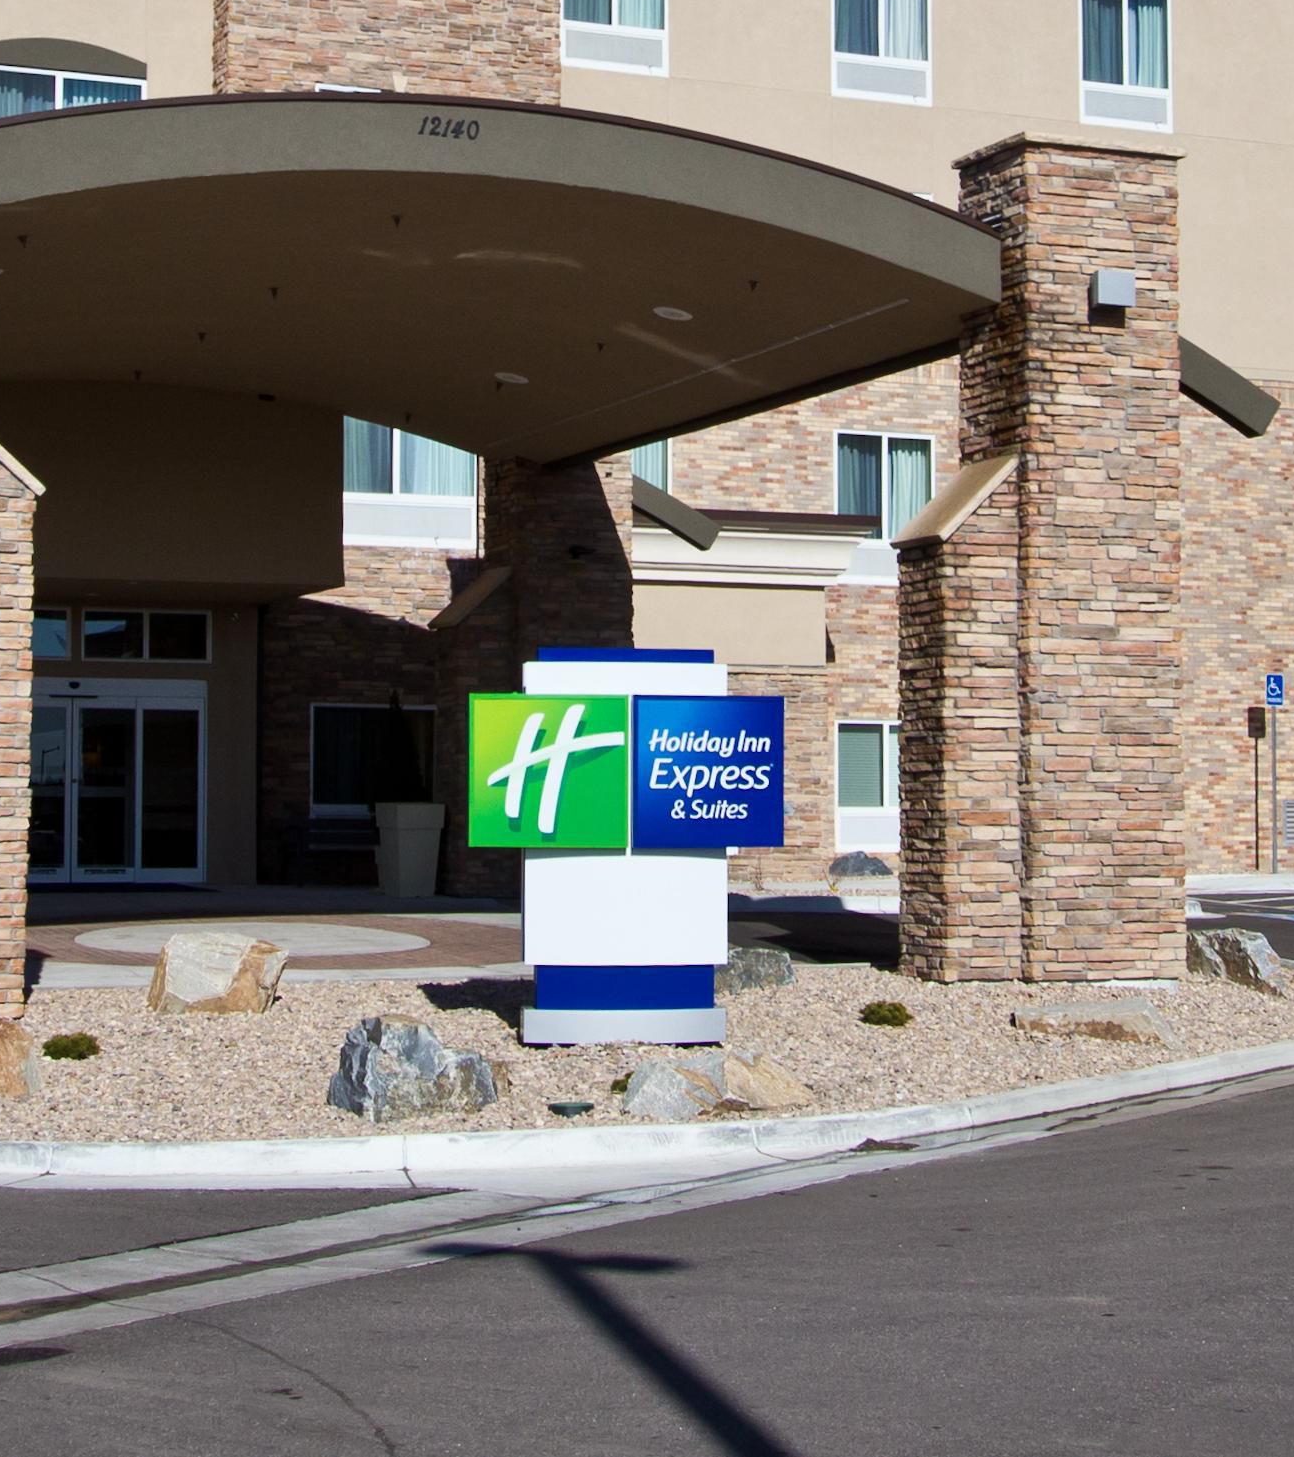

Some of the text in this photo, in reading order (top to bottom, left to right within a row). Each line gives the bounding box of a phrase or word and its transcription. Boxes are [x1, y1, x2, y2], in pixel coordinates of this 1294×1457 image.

[418, 116, 480, 140] 12140
[648, 728, 771, 758] Holiday Inn
[648, 757, 771, 798] Express
[670, 799, 748, 820] & Suites
